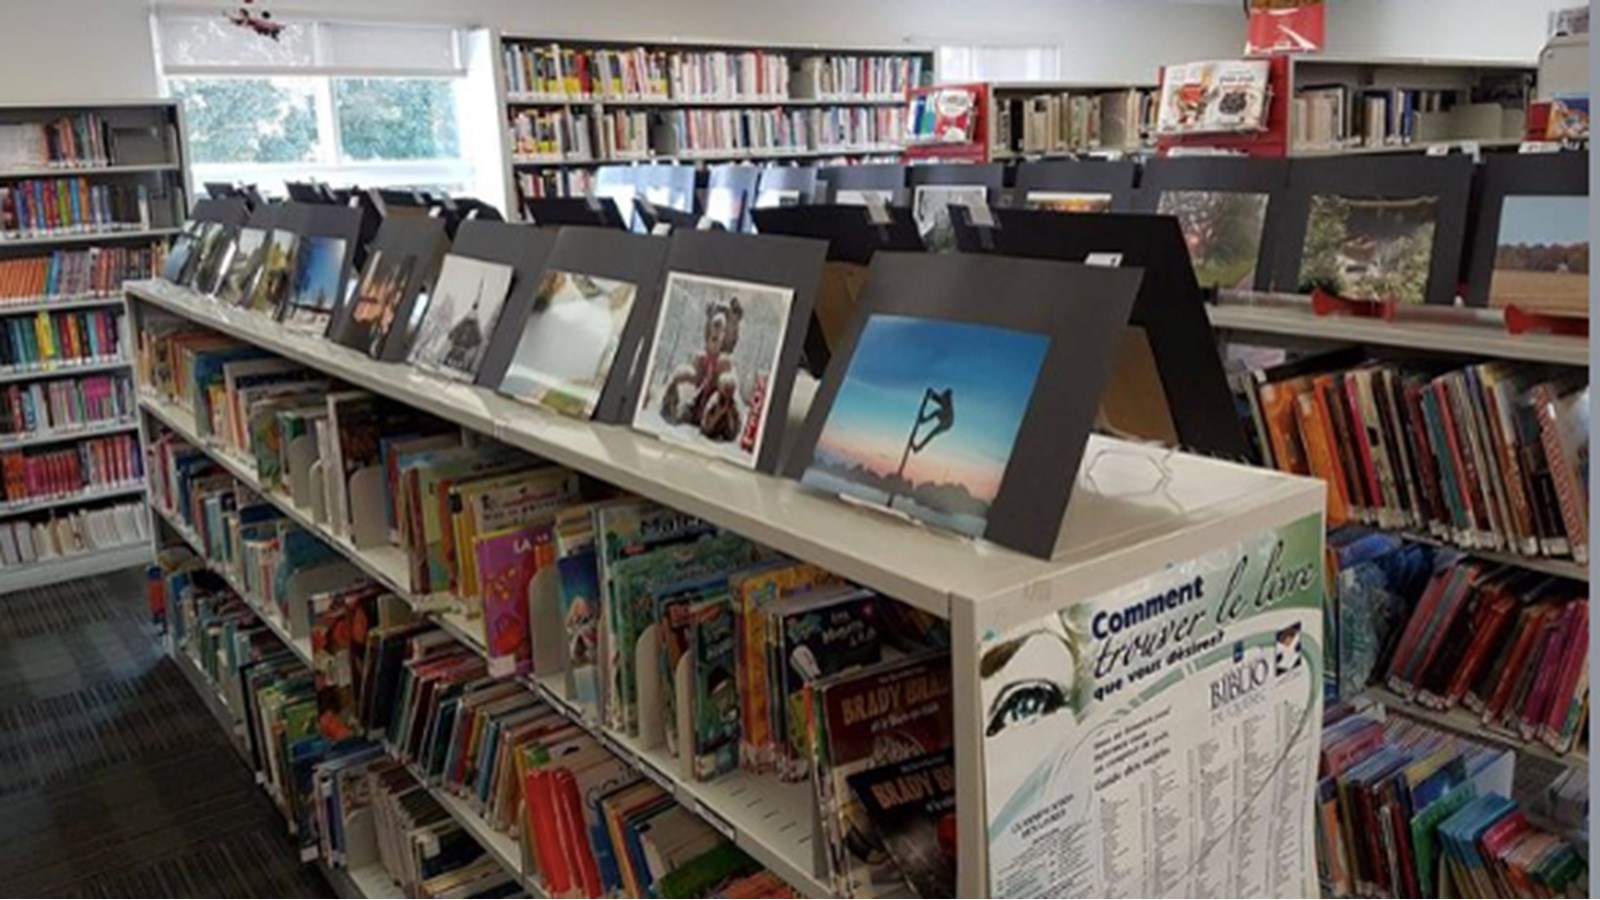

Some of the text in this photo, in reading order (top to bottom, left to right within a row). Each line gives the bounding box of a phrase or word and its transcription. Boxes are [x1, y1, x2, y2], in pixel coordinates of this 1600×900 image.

[1092, 575, 1204, 639] Comment
[1094, 610, 1206, 678] trouver
[1216, 554, 1248, 624] le
[1094, 678, 1122, 701] que
[1128, 659, 1162, 683] vous
[1210, 658, 1269, 709] BIBLIO
[841, 683, 901, 726] BRADY
[870, 769, 935, 811] BRADY
